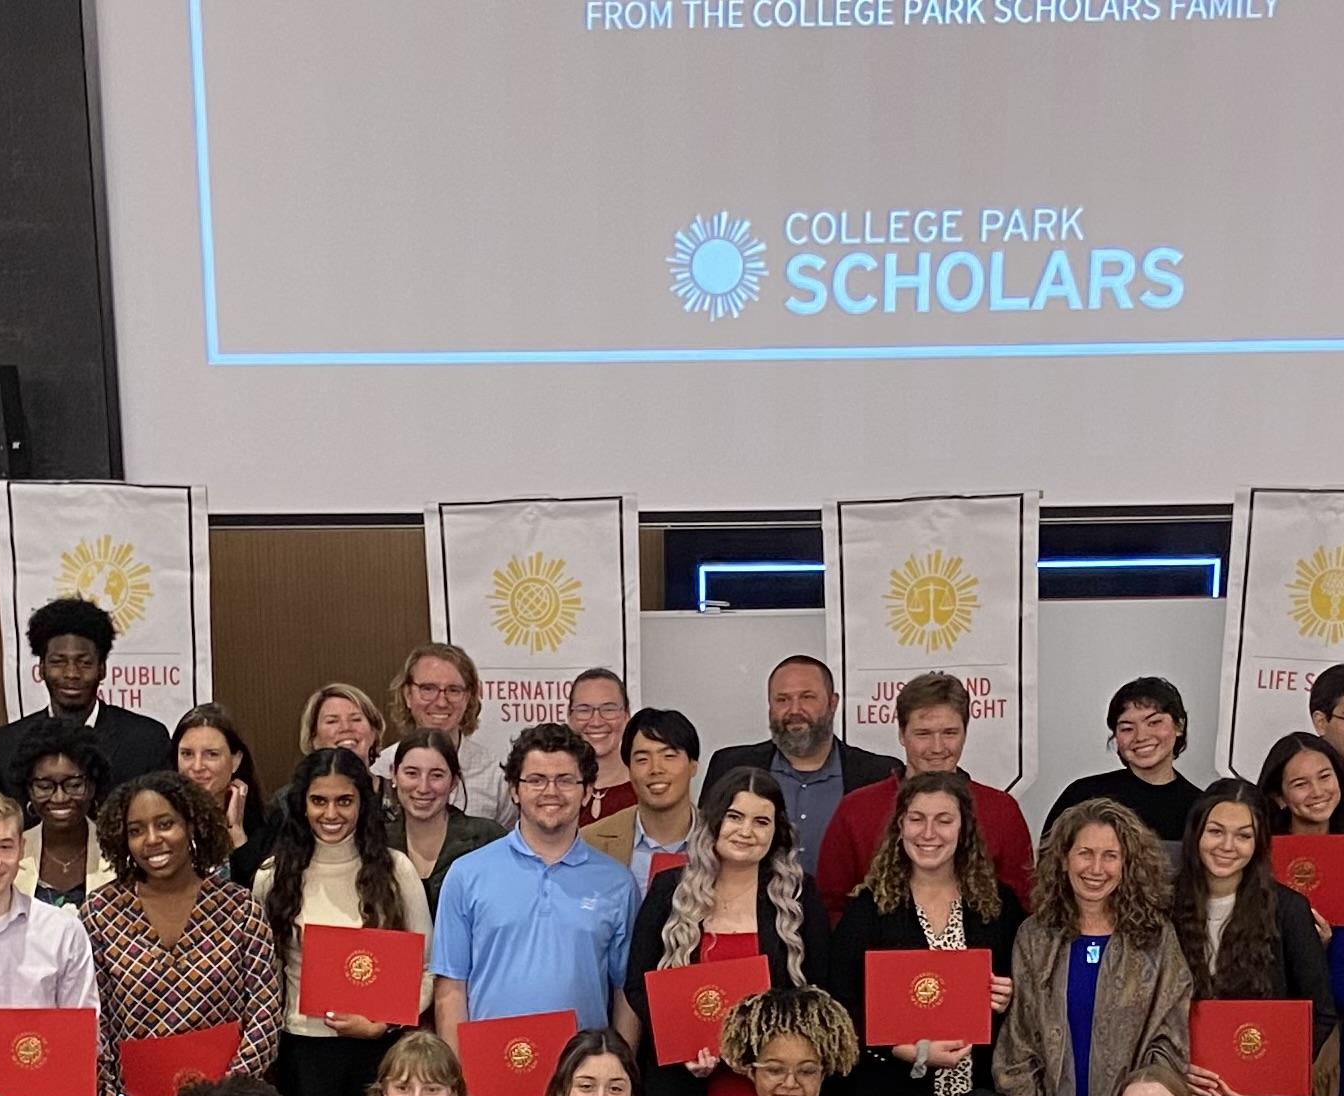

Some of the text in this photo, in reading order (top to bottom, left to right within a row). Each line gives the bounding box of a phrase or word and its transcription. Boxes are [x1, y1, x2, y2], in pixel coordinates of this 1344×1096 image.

[586, 0, 1278, 30] FROM THE COLLEGE PARK SCHOLARS FAMILY
[784, 206, 1085, 245] COLLEGE PARK
[783, 245, 1186, 316] SCHOLARS
[111, 665, 181, 686] PUBLIC
[1257, 669, 1298, 691] LIFE
[479, 680, 574, 700] TERNATIO
[966, 677, 992, 696] ND
[96, 688, 142, 709] ALTH
[501, 702, 566, 723] STUDIE
